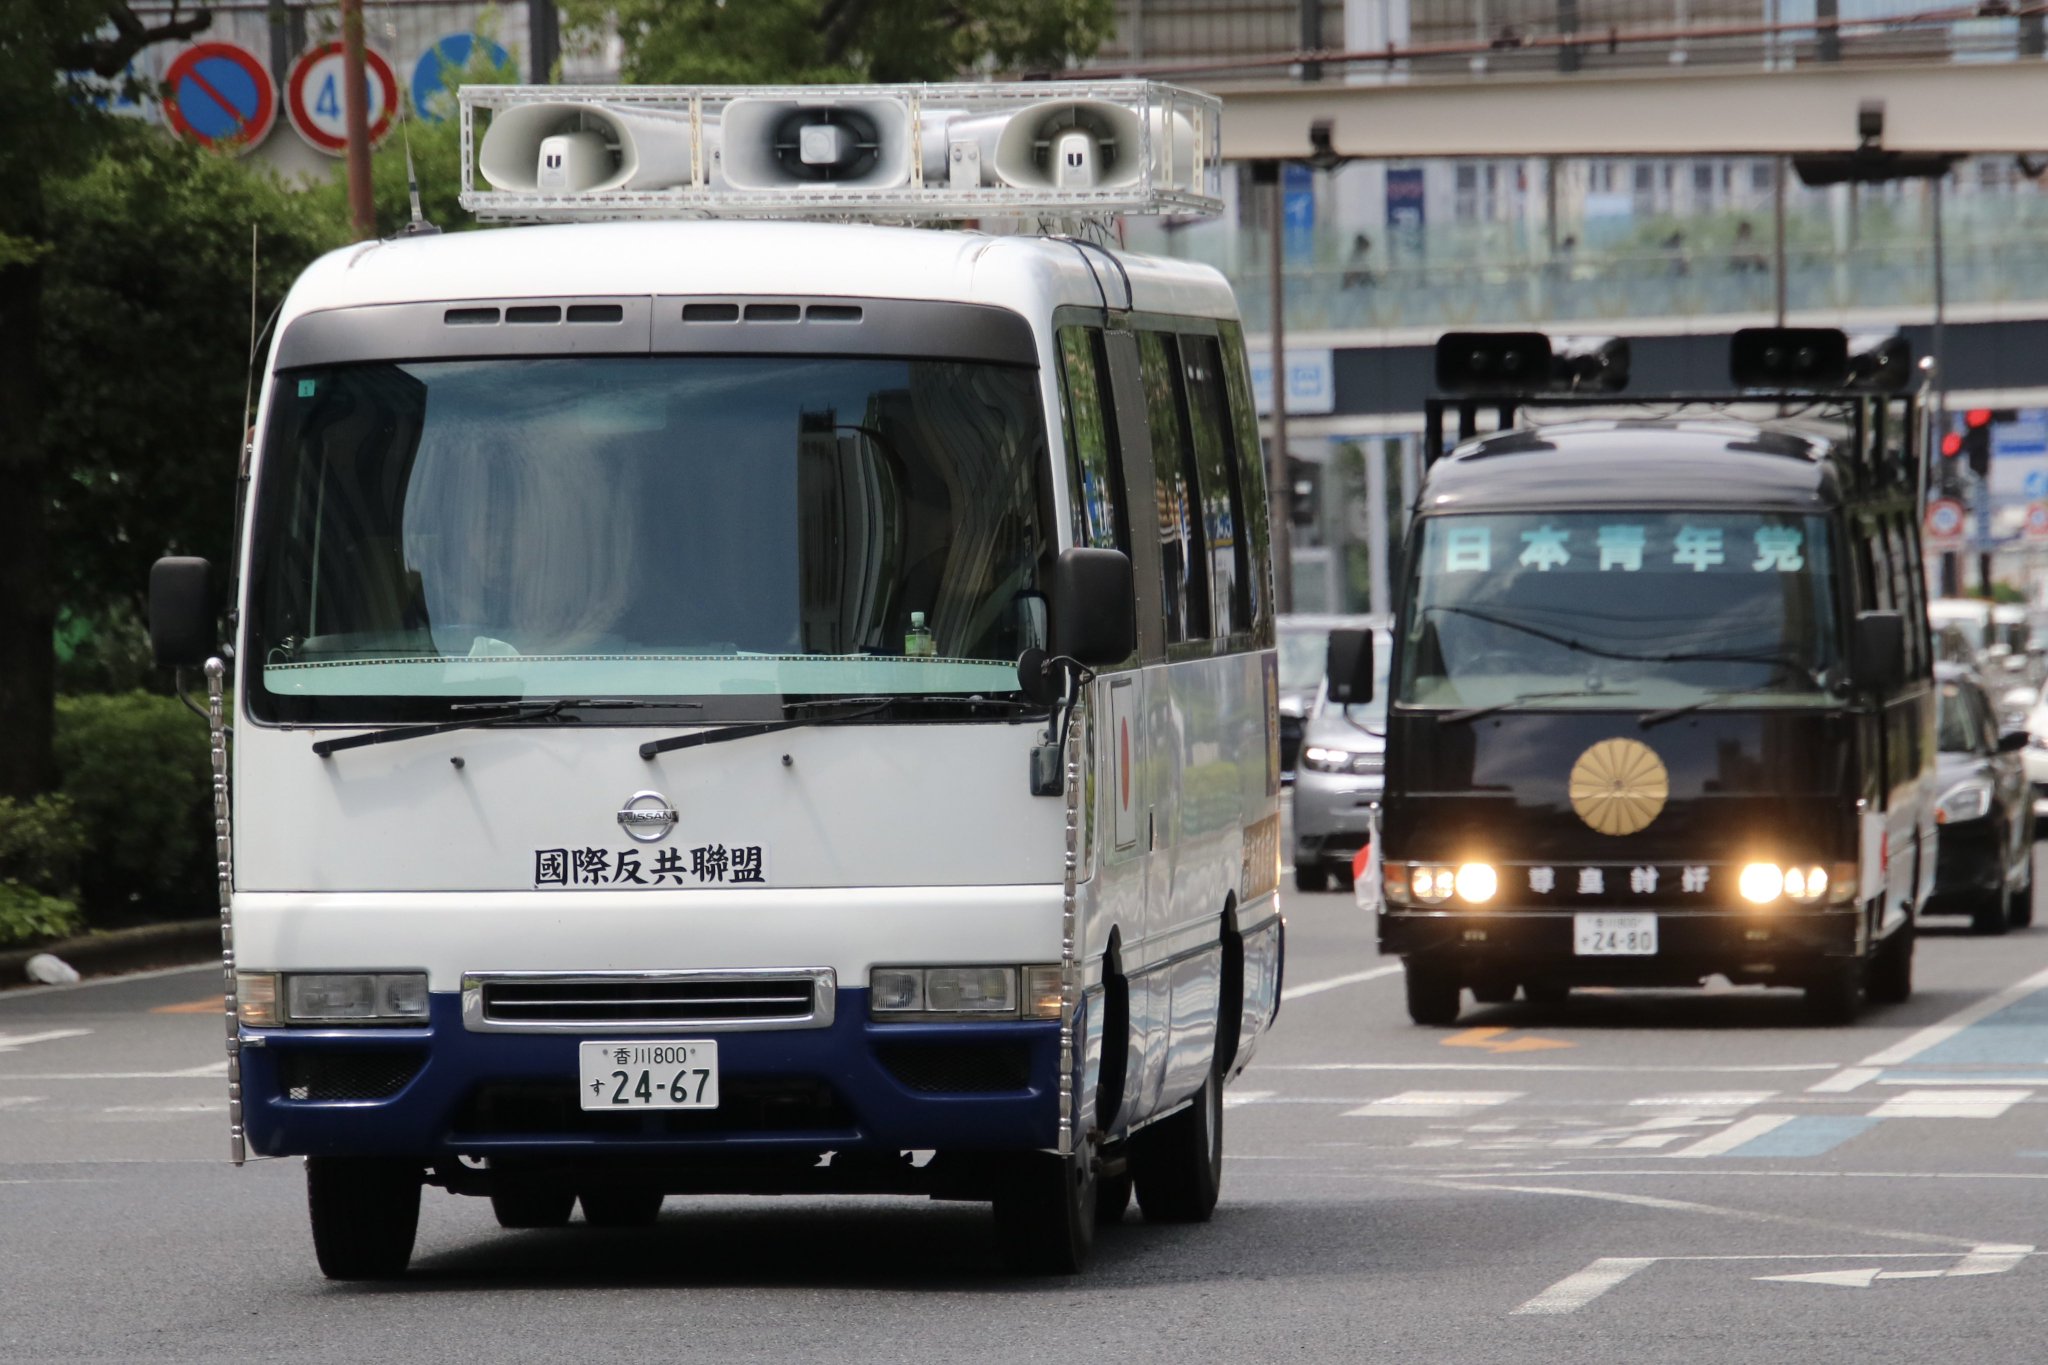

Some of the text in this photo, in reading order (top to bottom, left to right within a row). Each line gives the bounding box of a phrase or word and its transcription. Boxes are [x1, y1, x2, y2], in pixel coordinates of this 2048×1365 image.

[316, 73, 372, 119] 4
[1446, 524, 1804, 572] 日本青年党
[623, 811, 672, 823] NISSAN
[535, 844, 766, 886] 國際反共聯盟
[1593, 930, 1652, 951] 24-80
[613, 1047, 687, 1065] 香川800
[589, 1069, 710, 1104] す 24-67
